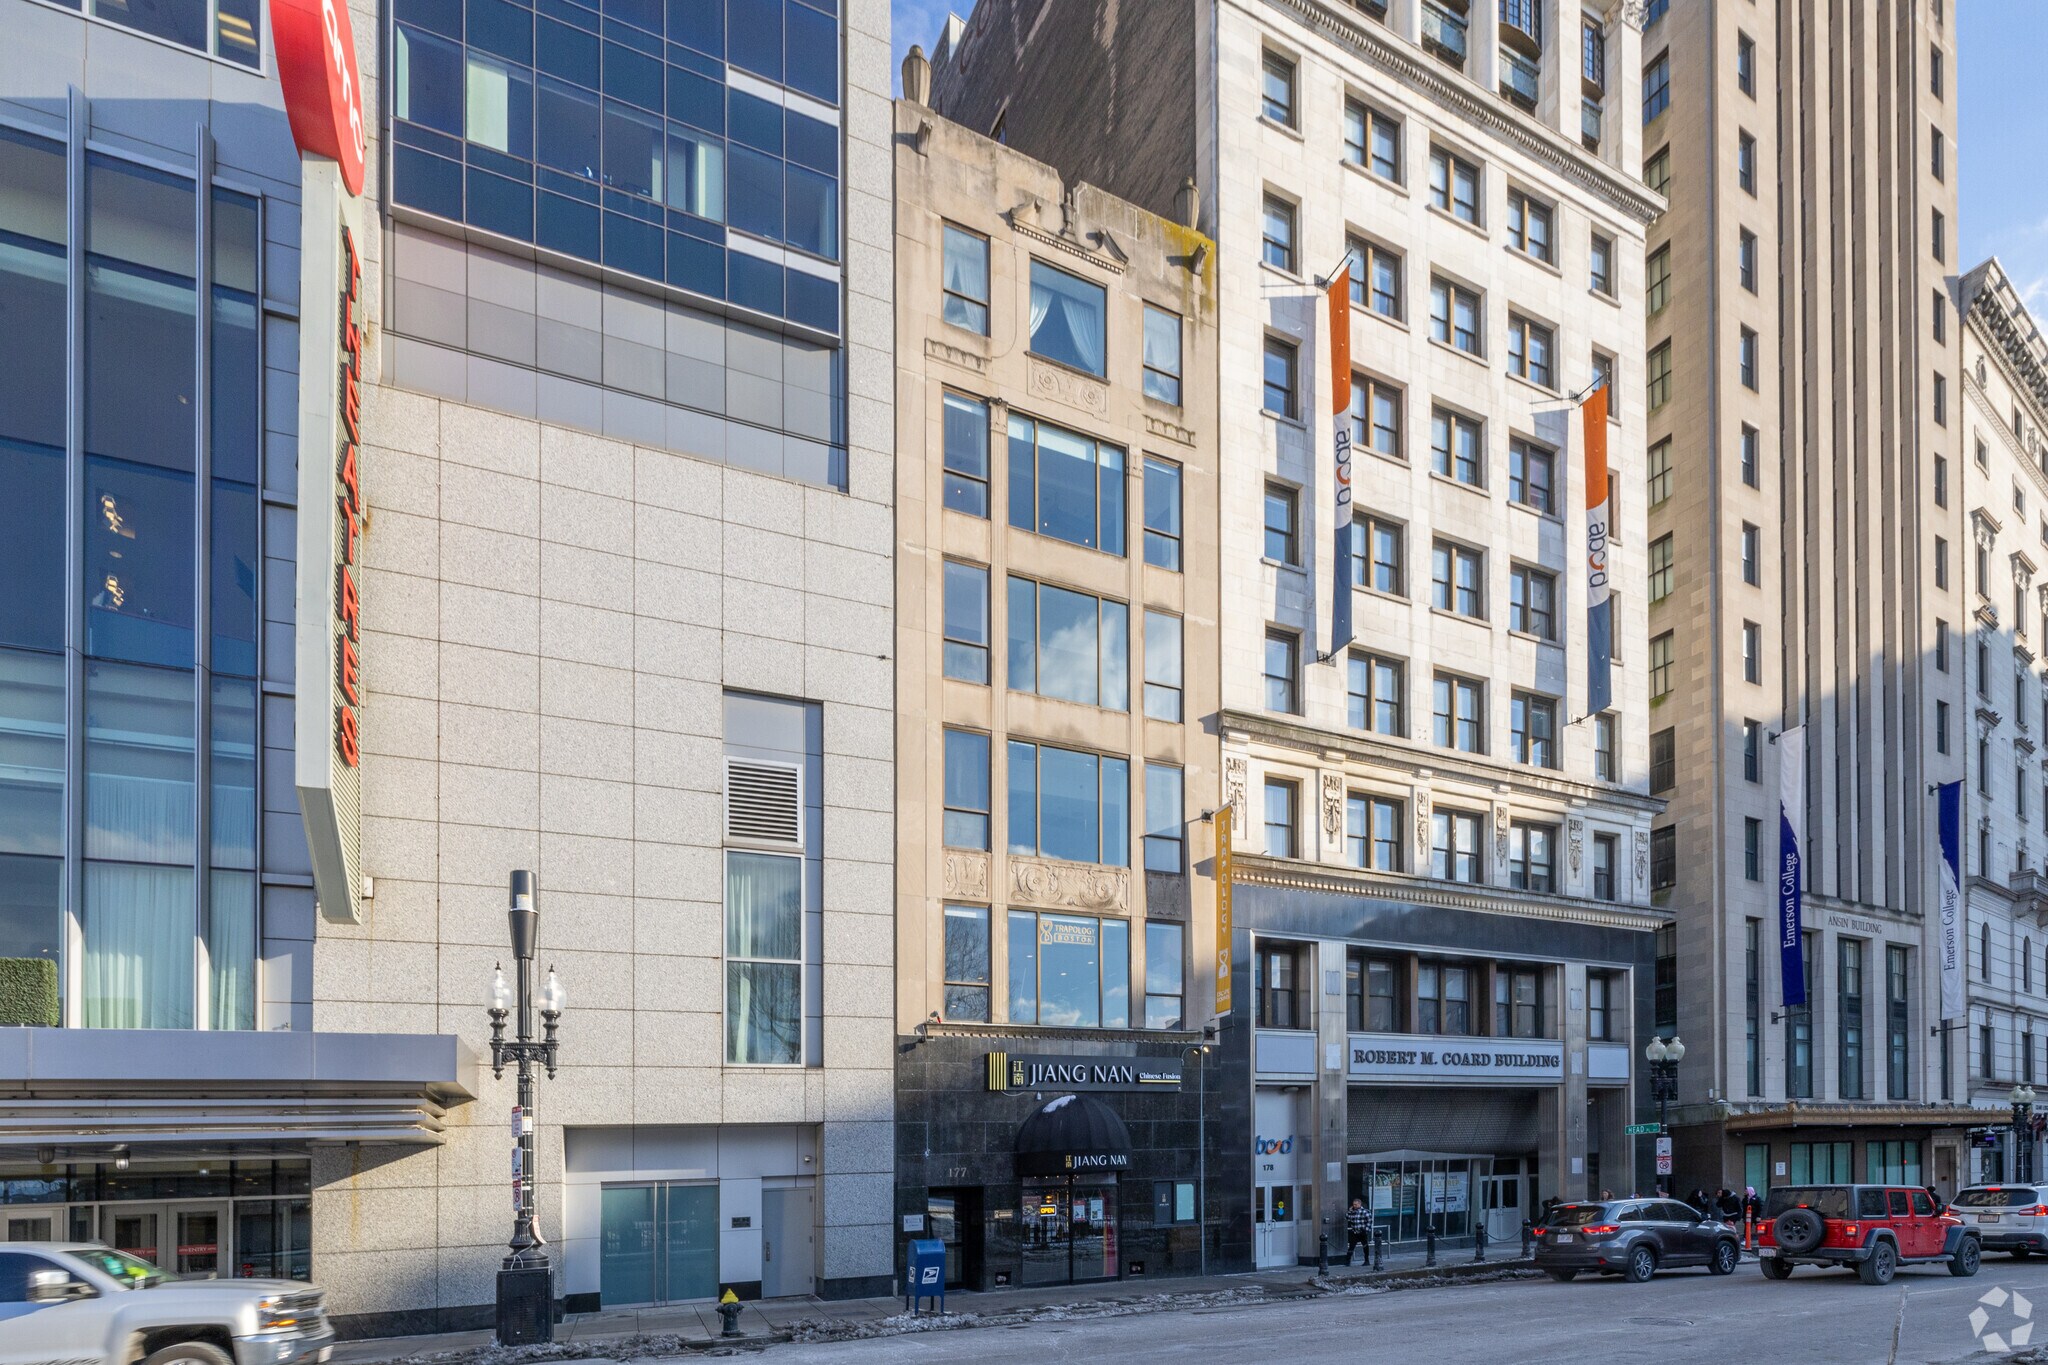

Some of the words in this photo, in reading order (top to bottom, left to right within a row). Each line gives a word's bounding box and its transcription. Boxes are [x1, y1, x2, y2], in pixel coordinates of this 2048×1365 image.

[338, 225, 362, 768] THEATRES
[1219, 819, 1229, 934] TRAPOLOGY
[1782, 852, 1798, 895] College
[1942, 889, 1957, 926] College
[1055, 924, 1096, 935] TRAPOLOGY
[1783, 897, 1796, 948] Emerson
[1828, 915, 1849, 929] ANSIN
[1851, 919, 1883, 934] BUILDING
[1057, 933, 1093, 943] BOSTON
[1943, 927, 1956, 971] Emerson
[1354, 1050, 1417, 1065] ROBERT
[1421, 1051, 1438, 1066] M.
[1442, 1052, 1491, 1067] COARD
[1495, 1053, 1560, 1068] BUILDING
[1013, 1060, 1024, 1086] 江南
[1030, 1063, 1086, 1086] JIANG
[1094, 1064, 1133, 1083] NAN
[1140, 1072, 1161, 1080] Chinese
[1162, 1072, 1181, 1080] Fusion
[1628, 1126, 1645, 1134] HEAD
[948, 1167, 967, 1178] 177
[1073, 1155, 1107, 1169] JIANG
[1110, 1154, 1127, 1165] NAN
